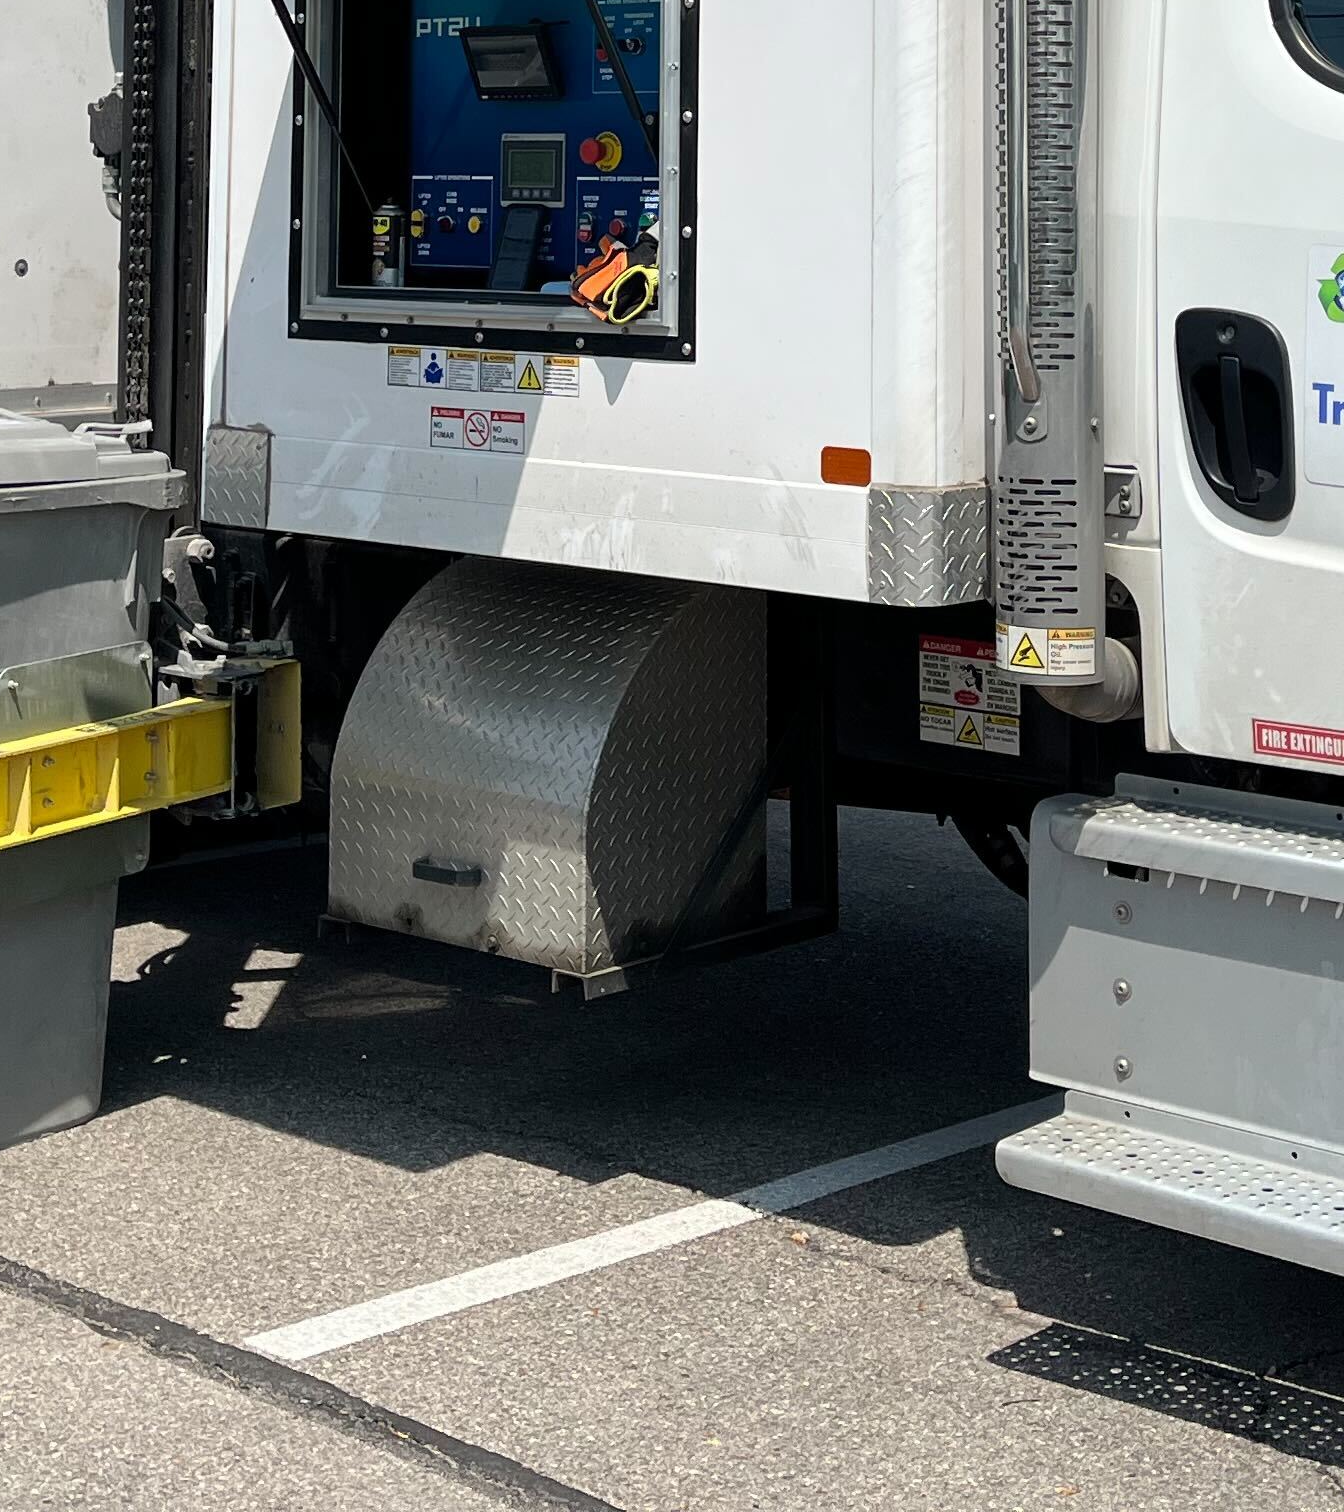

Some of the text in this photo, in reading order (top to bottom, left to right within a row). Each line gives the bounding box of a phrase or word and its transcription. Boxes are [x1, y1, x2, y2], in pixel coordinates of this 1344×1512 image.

[433, 421, 443, 429] NO
[492, 426, 502, 434] NO
[929, 641, 962, 653] DANGER
[1260, 727, 1289, 751] FIRE
